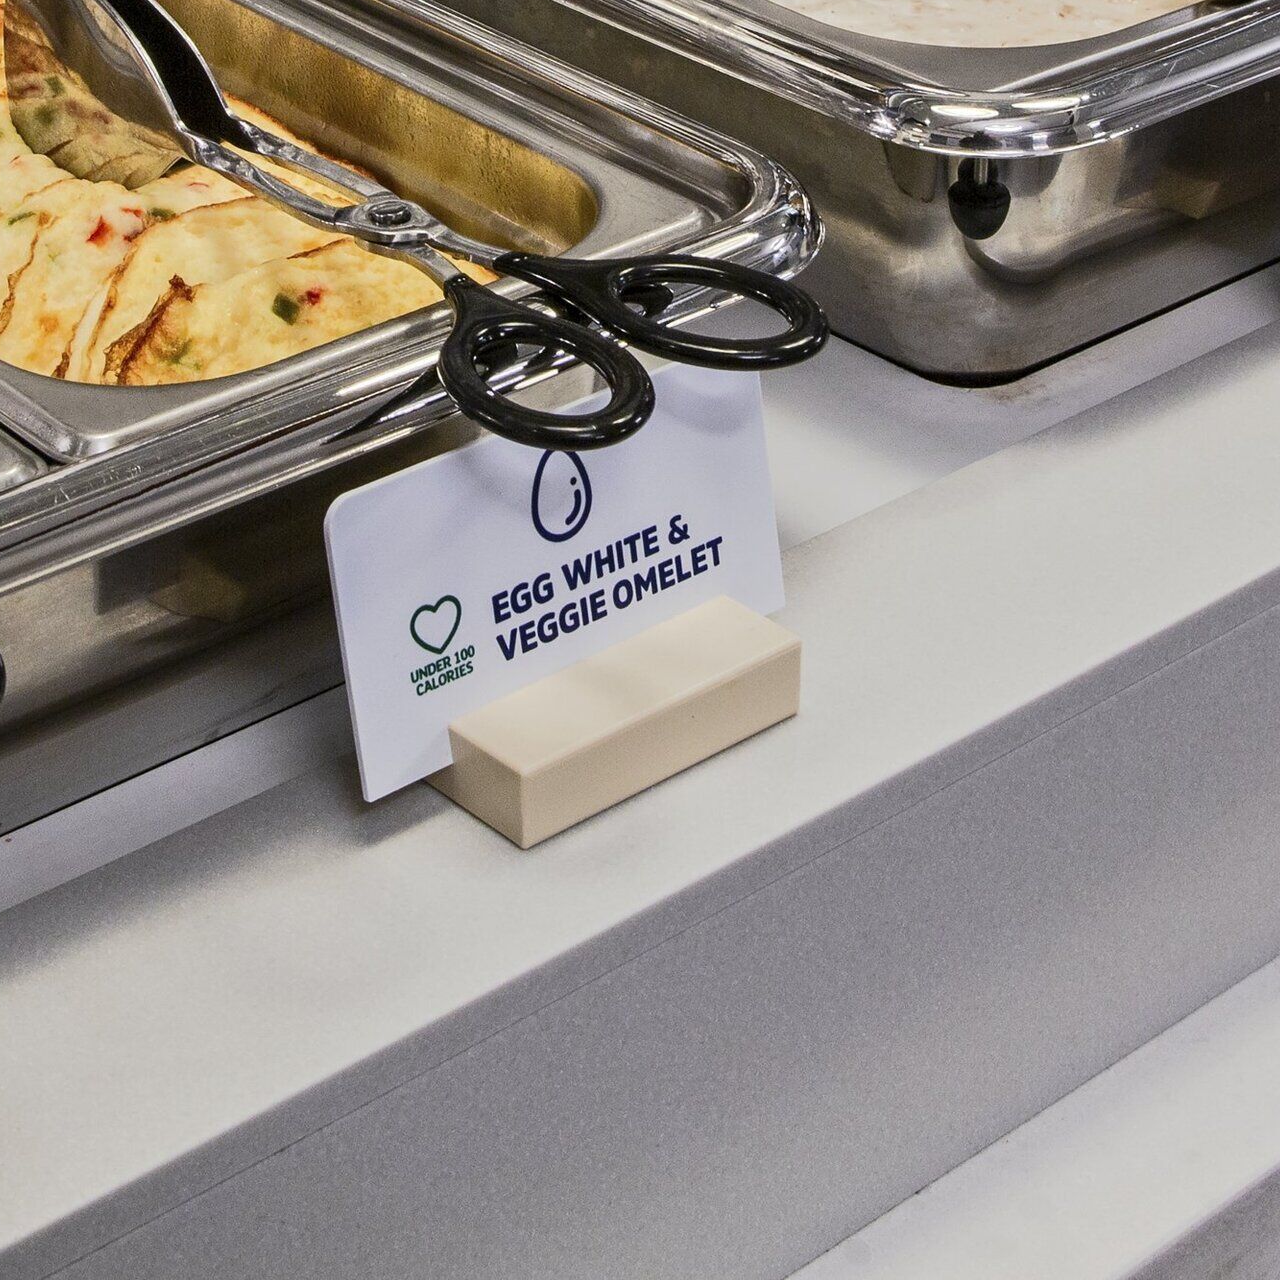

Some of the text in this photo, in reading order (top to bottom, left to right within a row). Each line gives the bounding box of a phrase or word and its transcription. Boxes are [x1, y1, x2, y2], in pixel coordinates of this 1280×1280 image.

[491, 514, 691, 625] EGG WHITE &
[495, 535, 724, 662] VEGGIE OMELET
[409, 644, 476, 685] UNDER 100
[414, 660, 475, 697] CALORIES
